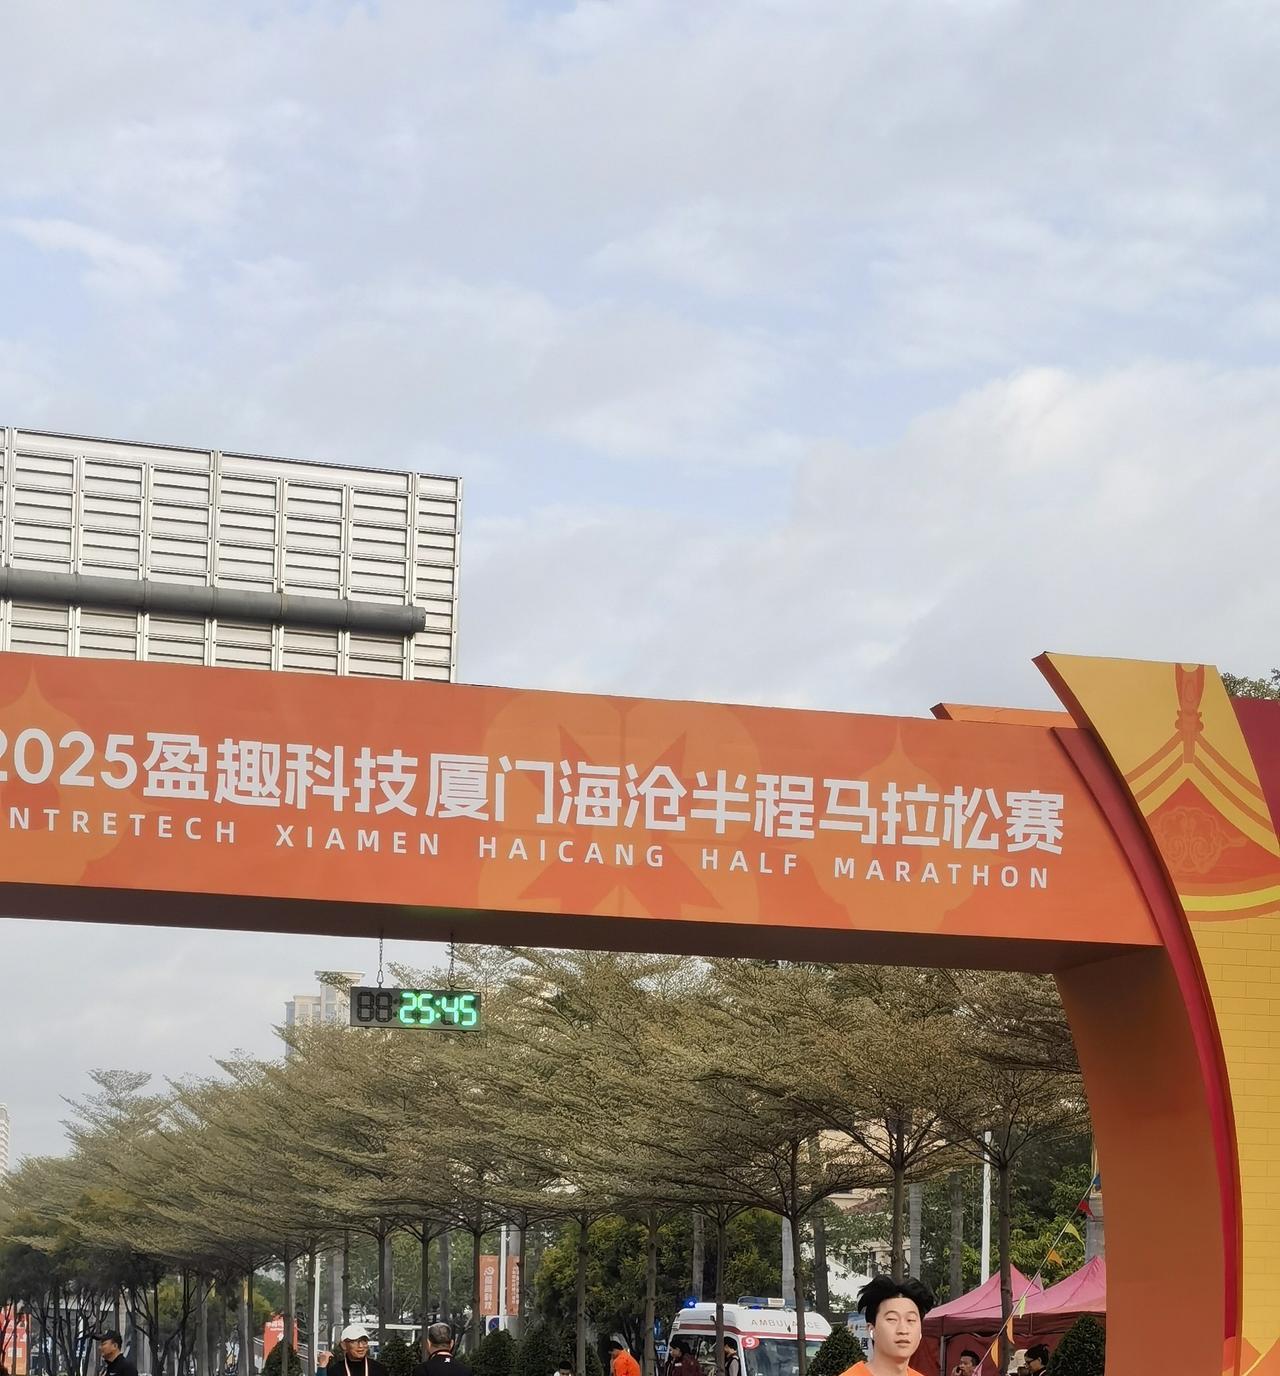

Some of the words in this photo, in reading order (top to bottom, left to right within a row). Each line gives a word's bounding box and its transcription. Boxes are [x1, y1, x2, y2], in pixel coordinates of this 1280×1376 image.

[0, 728, 1064, 855] 025盈趣科技厦门海沧半程马拉松赛
[9, 806, 235, 843] NTRETECH
[276, 824, 439, 856] XIAMEN
[479, 836, 665, 868] HAICANG
[701, 848, 799, 875] HALF
[834, 857, 1049, 889] MARATHON
[400, 992, 477, 1026] 25:45
[751, 1319, 822, 1329] AMBULACE
[745, 1337, 756, 1348] 9
